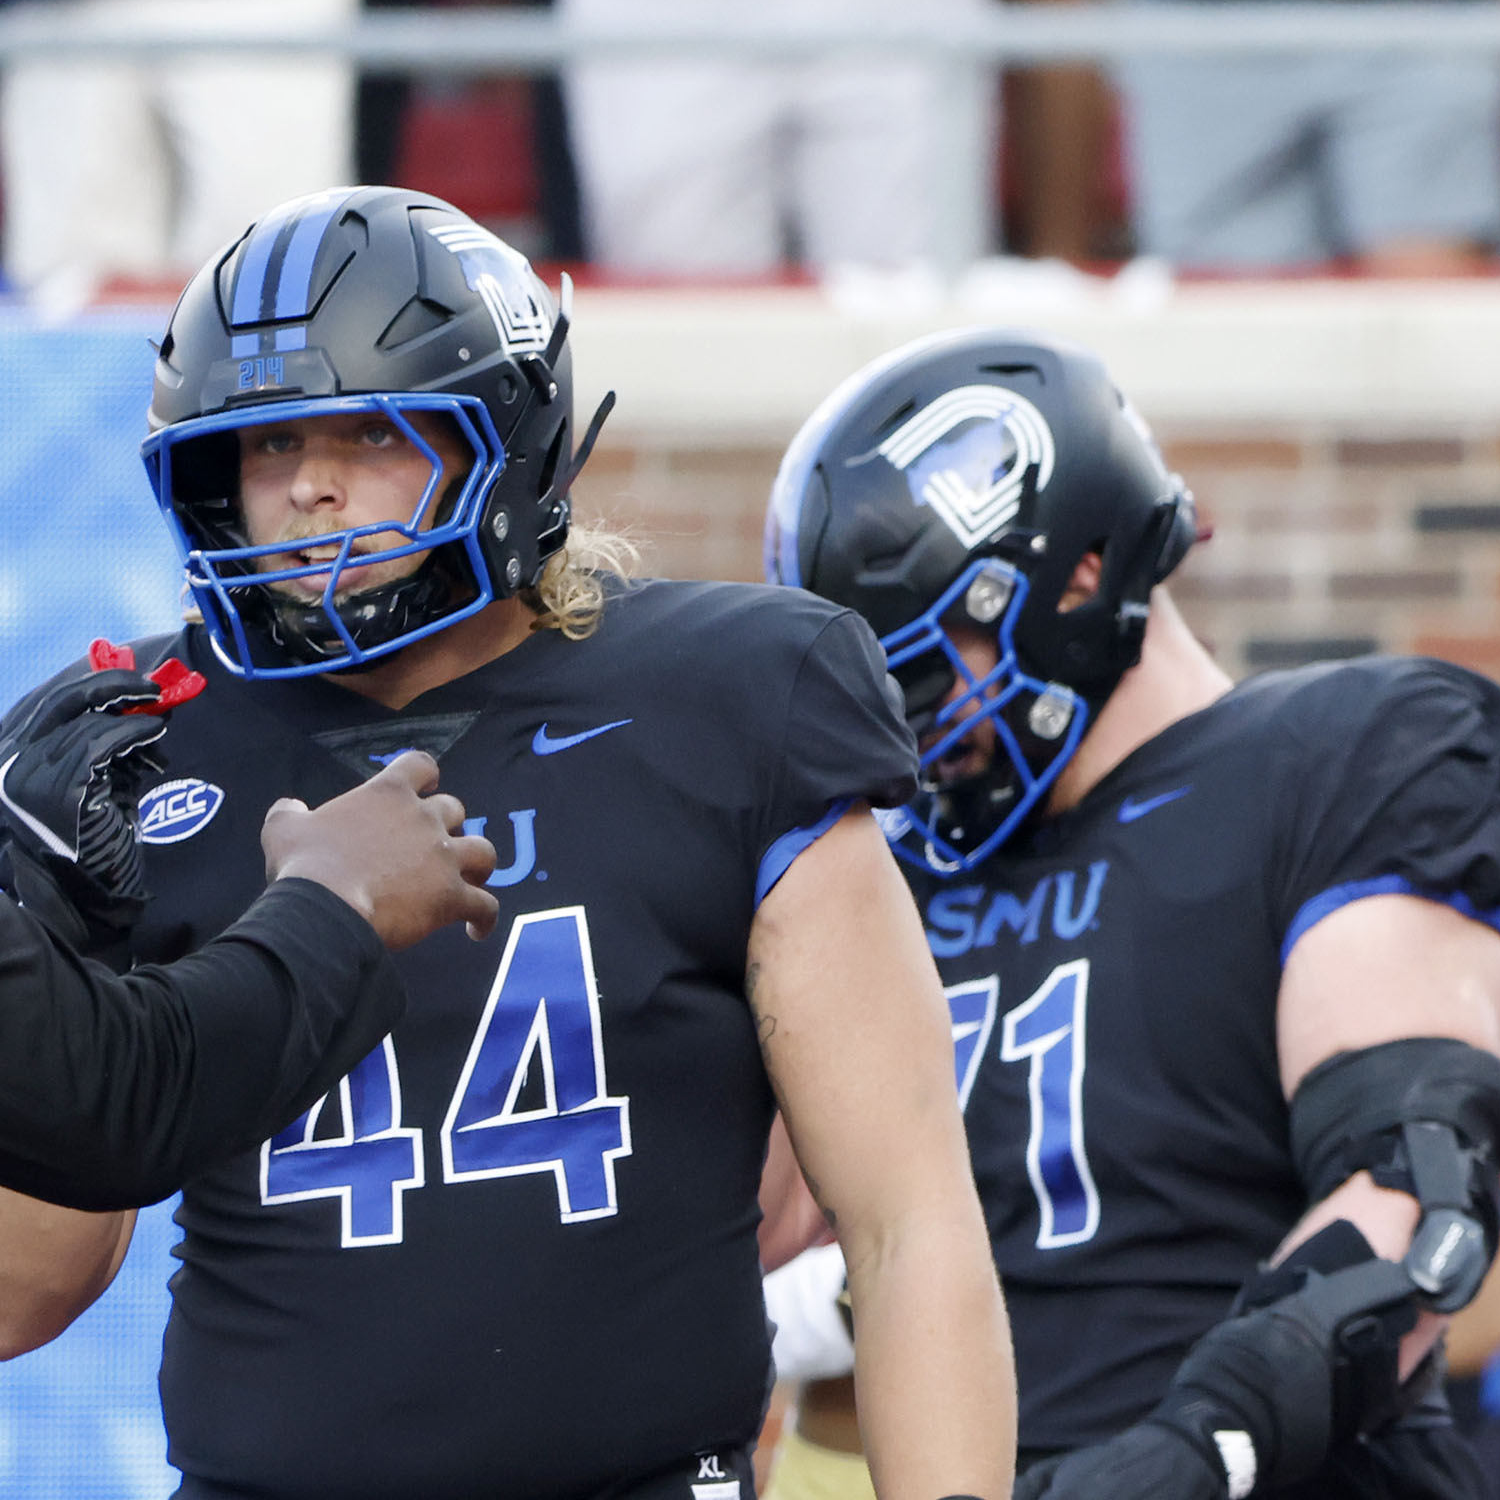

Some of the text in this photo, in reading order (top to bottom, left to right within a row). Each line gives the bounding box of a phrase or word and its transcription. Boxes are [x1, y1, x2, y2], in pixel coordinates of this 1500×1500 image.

[238, 356, 284, 389] 214
[141, 783, 208, 829] ACC
[926, 859, 1110, 958] SMU
[260, 905, 632, 1249] 44
[697, 1454, 727, 1479] XL
